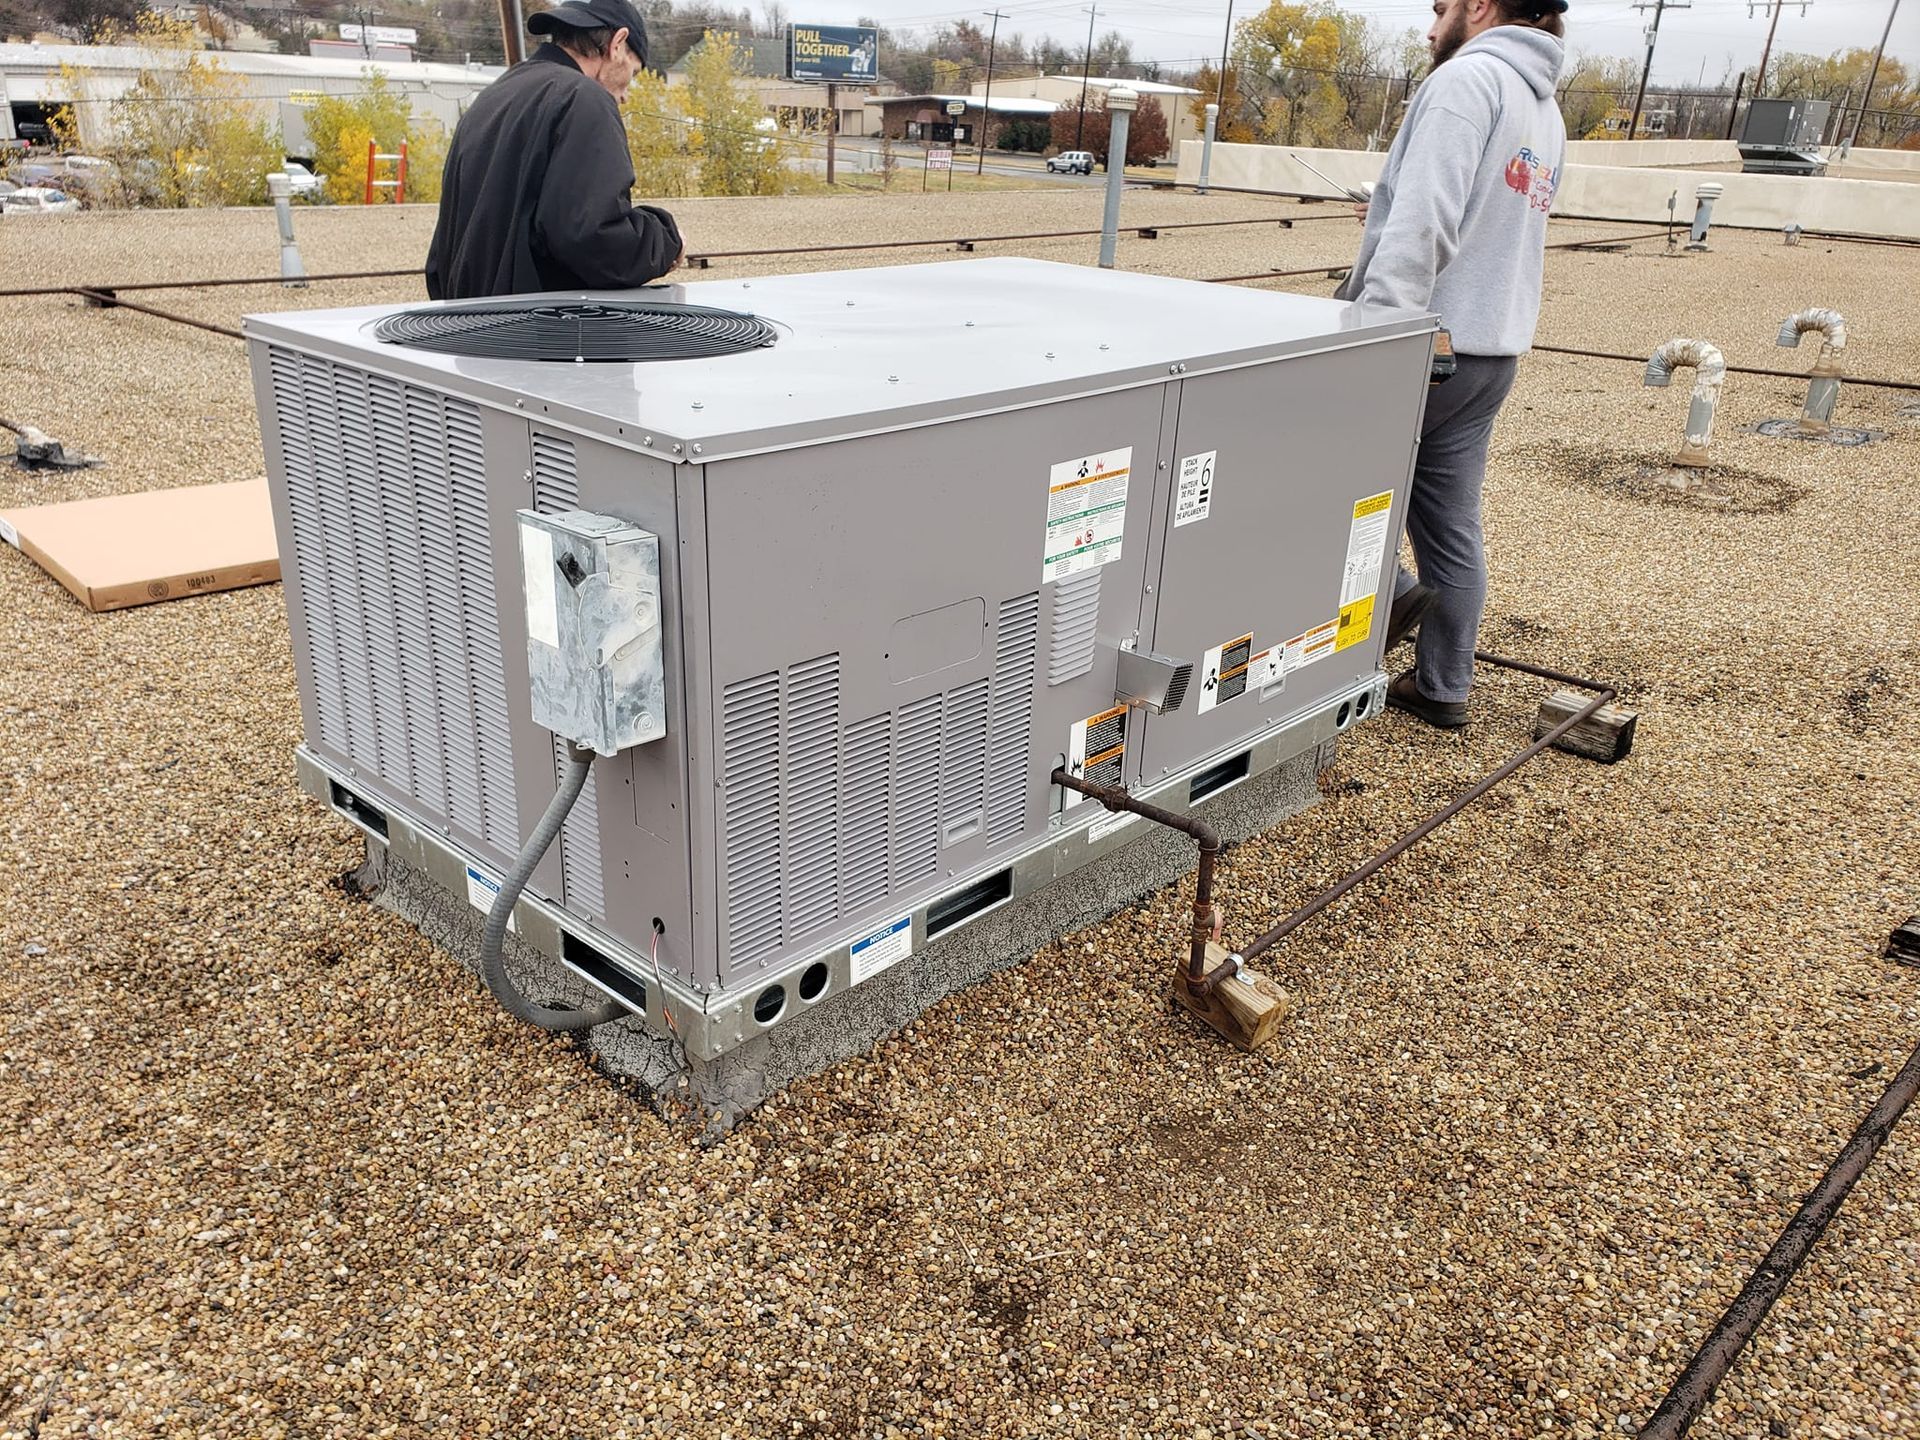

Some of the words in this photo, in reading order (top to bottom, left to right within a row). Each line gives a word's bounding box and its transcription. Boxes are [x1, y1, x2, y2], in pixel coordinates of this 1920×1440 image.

[795, 29, 821, 42] PULL
[796, 43, 849, 56] TOGETHER
[1183, 467, 1199, 478] HEIGHT
[1185, 458, 1198, 468] STACK
[1201, 457, 1212, 487] 6
[1180, 480, 1199, 491] HAUTEUR
[1179, 500, 1194, 511] ALTURA
[1099, 708, 1120, 721] WARNING
[869, 927, 894, 945] NOTICE
